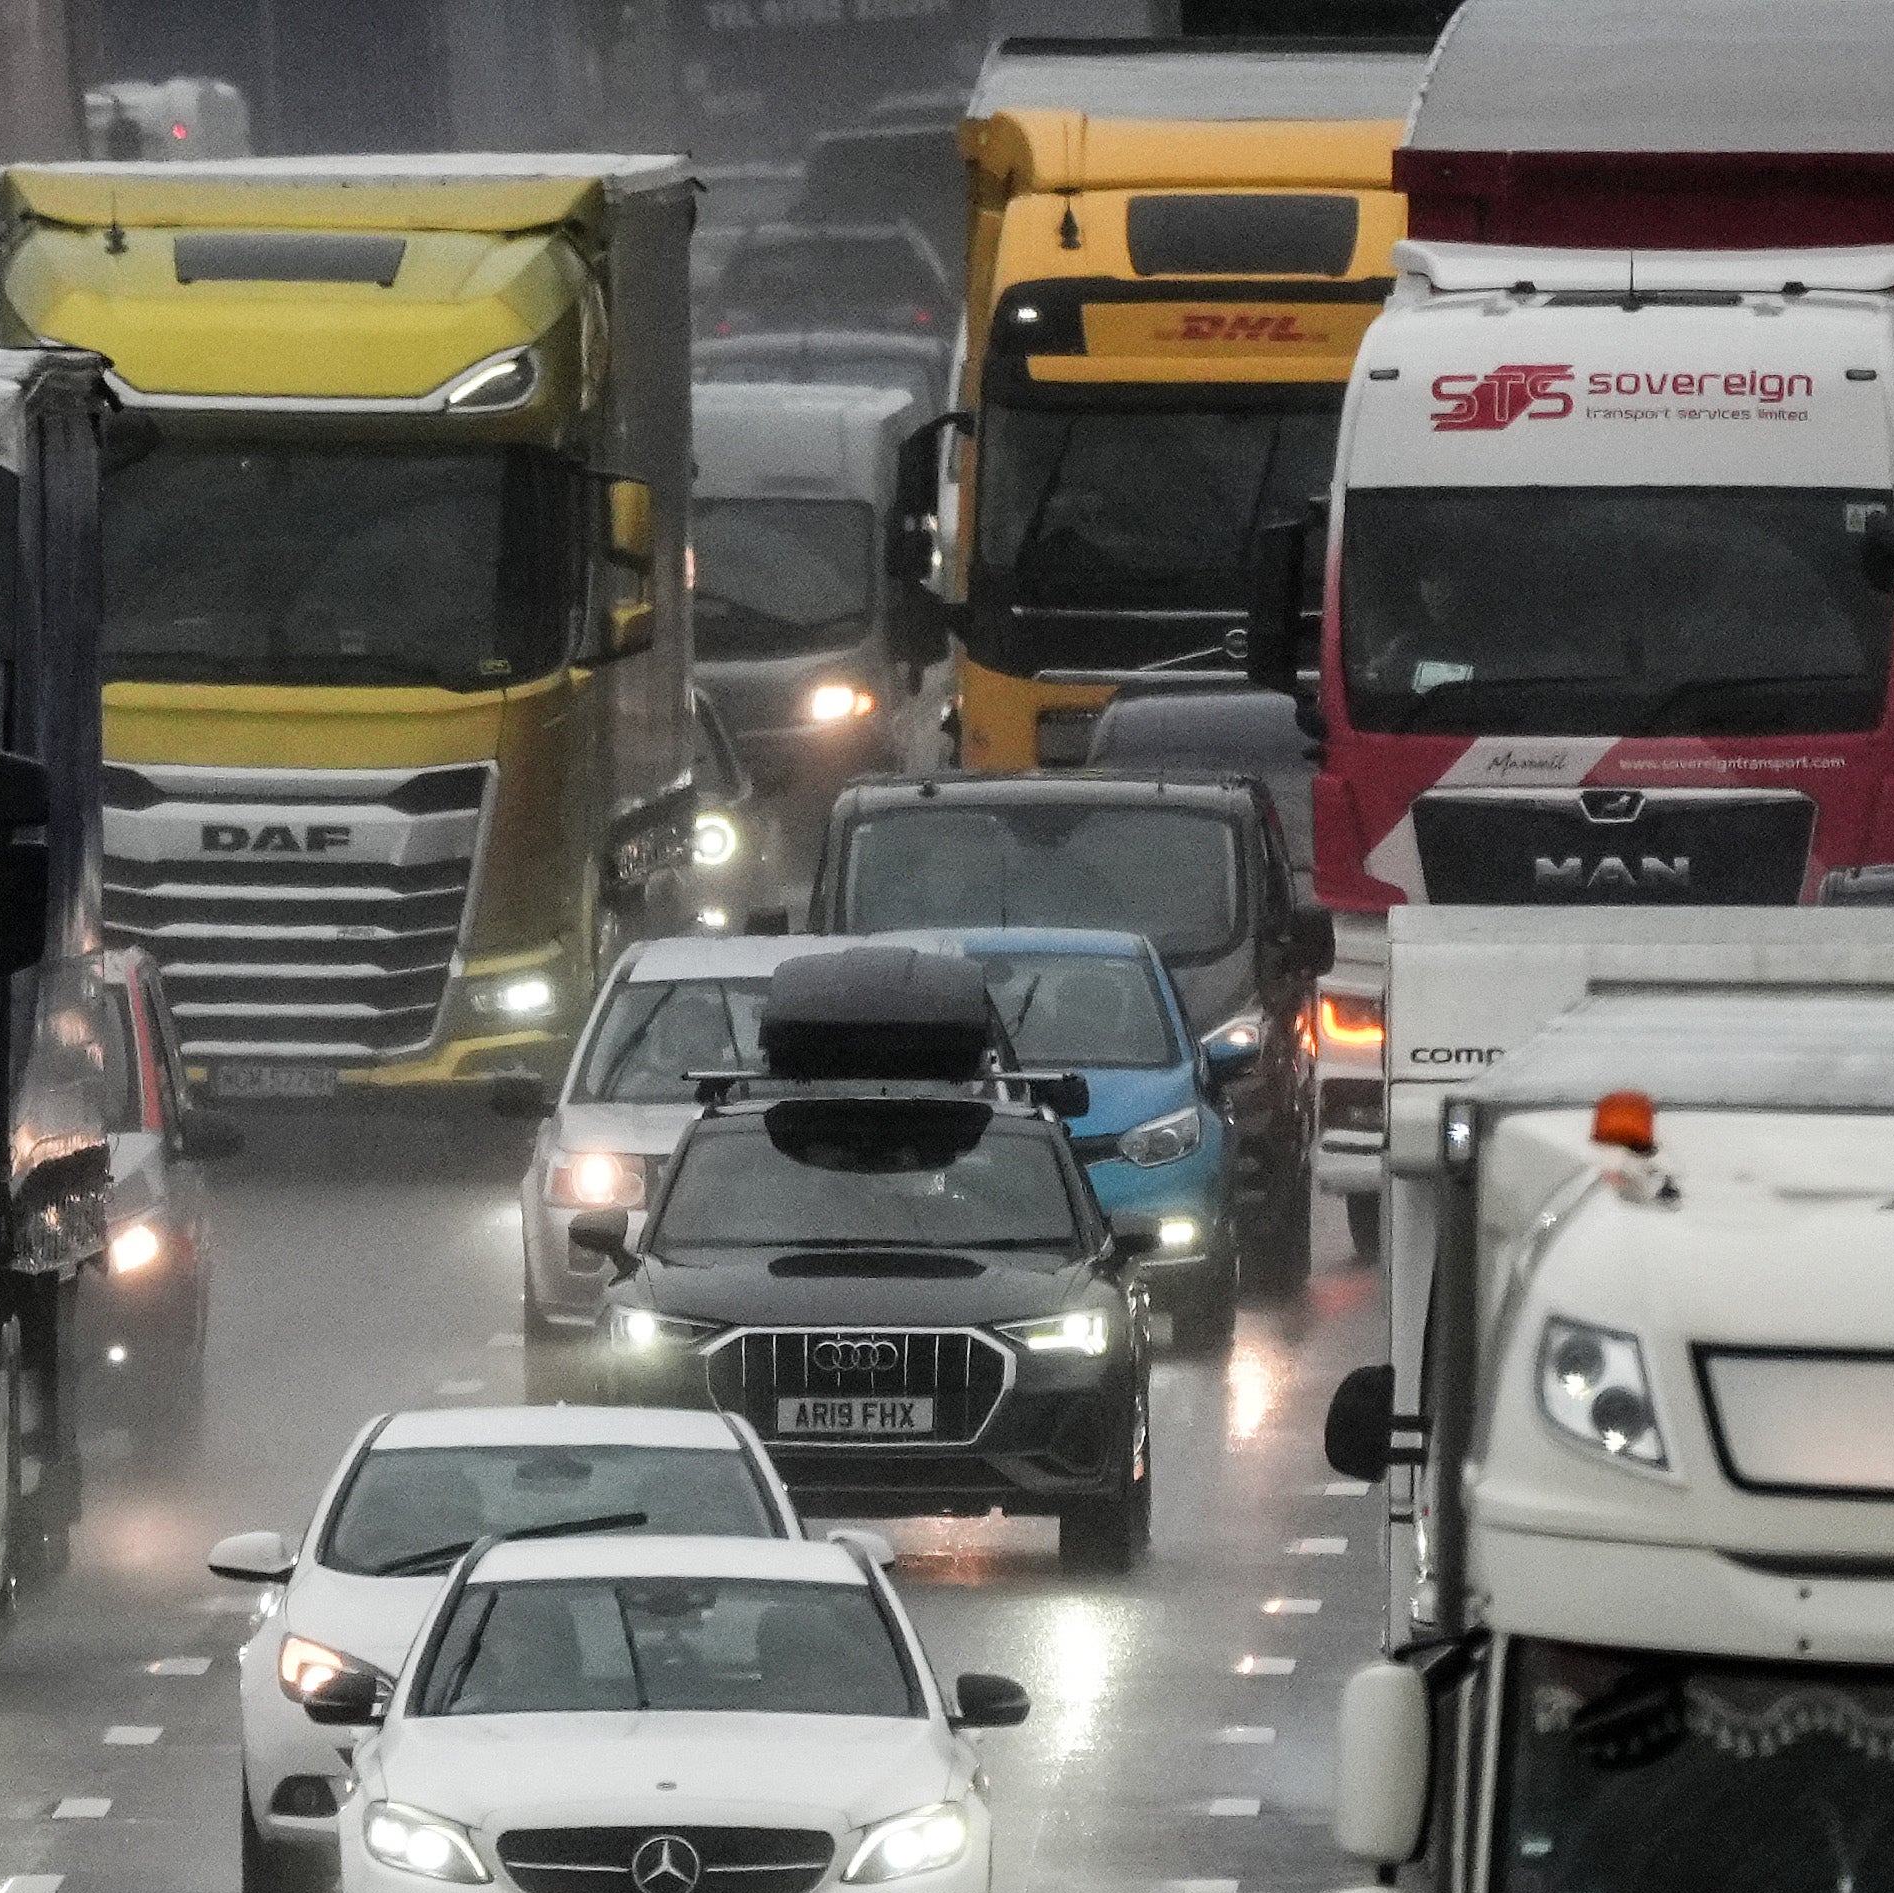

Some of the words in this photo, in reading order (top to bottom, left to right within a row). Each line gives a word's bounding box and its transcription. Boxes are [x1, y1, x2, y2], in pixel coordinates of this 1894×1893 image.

[1182, 315, 1304, 341] DHL
[1430, 370, 1575, 425] STS
[1587, 369, 1812, 403] sovereign
[1586, 406, 1670, 421] transport
[1678, 407, 1752, 421] services
[1757, 407, 1810, 422] limited
[1618, 756, 1847, 773] www.sovereigntransport.com
[201, 825, 351, 853] DAF
[1534, 856, 1691, 888] MAN
[795, 1402, 853, 1428] AR19
[862, 1402, 915, 1428] FHX
